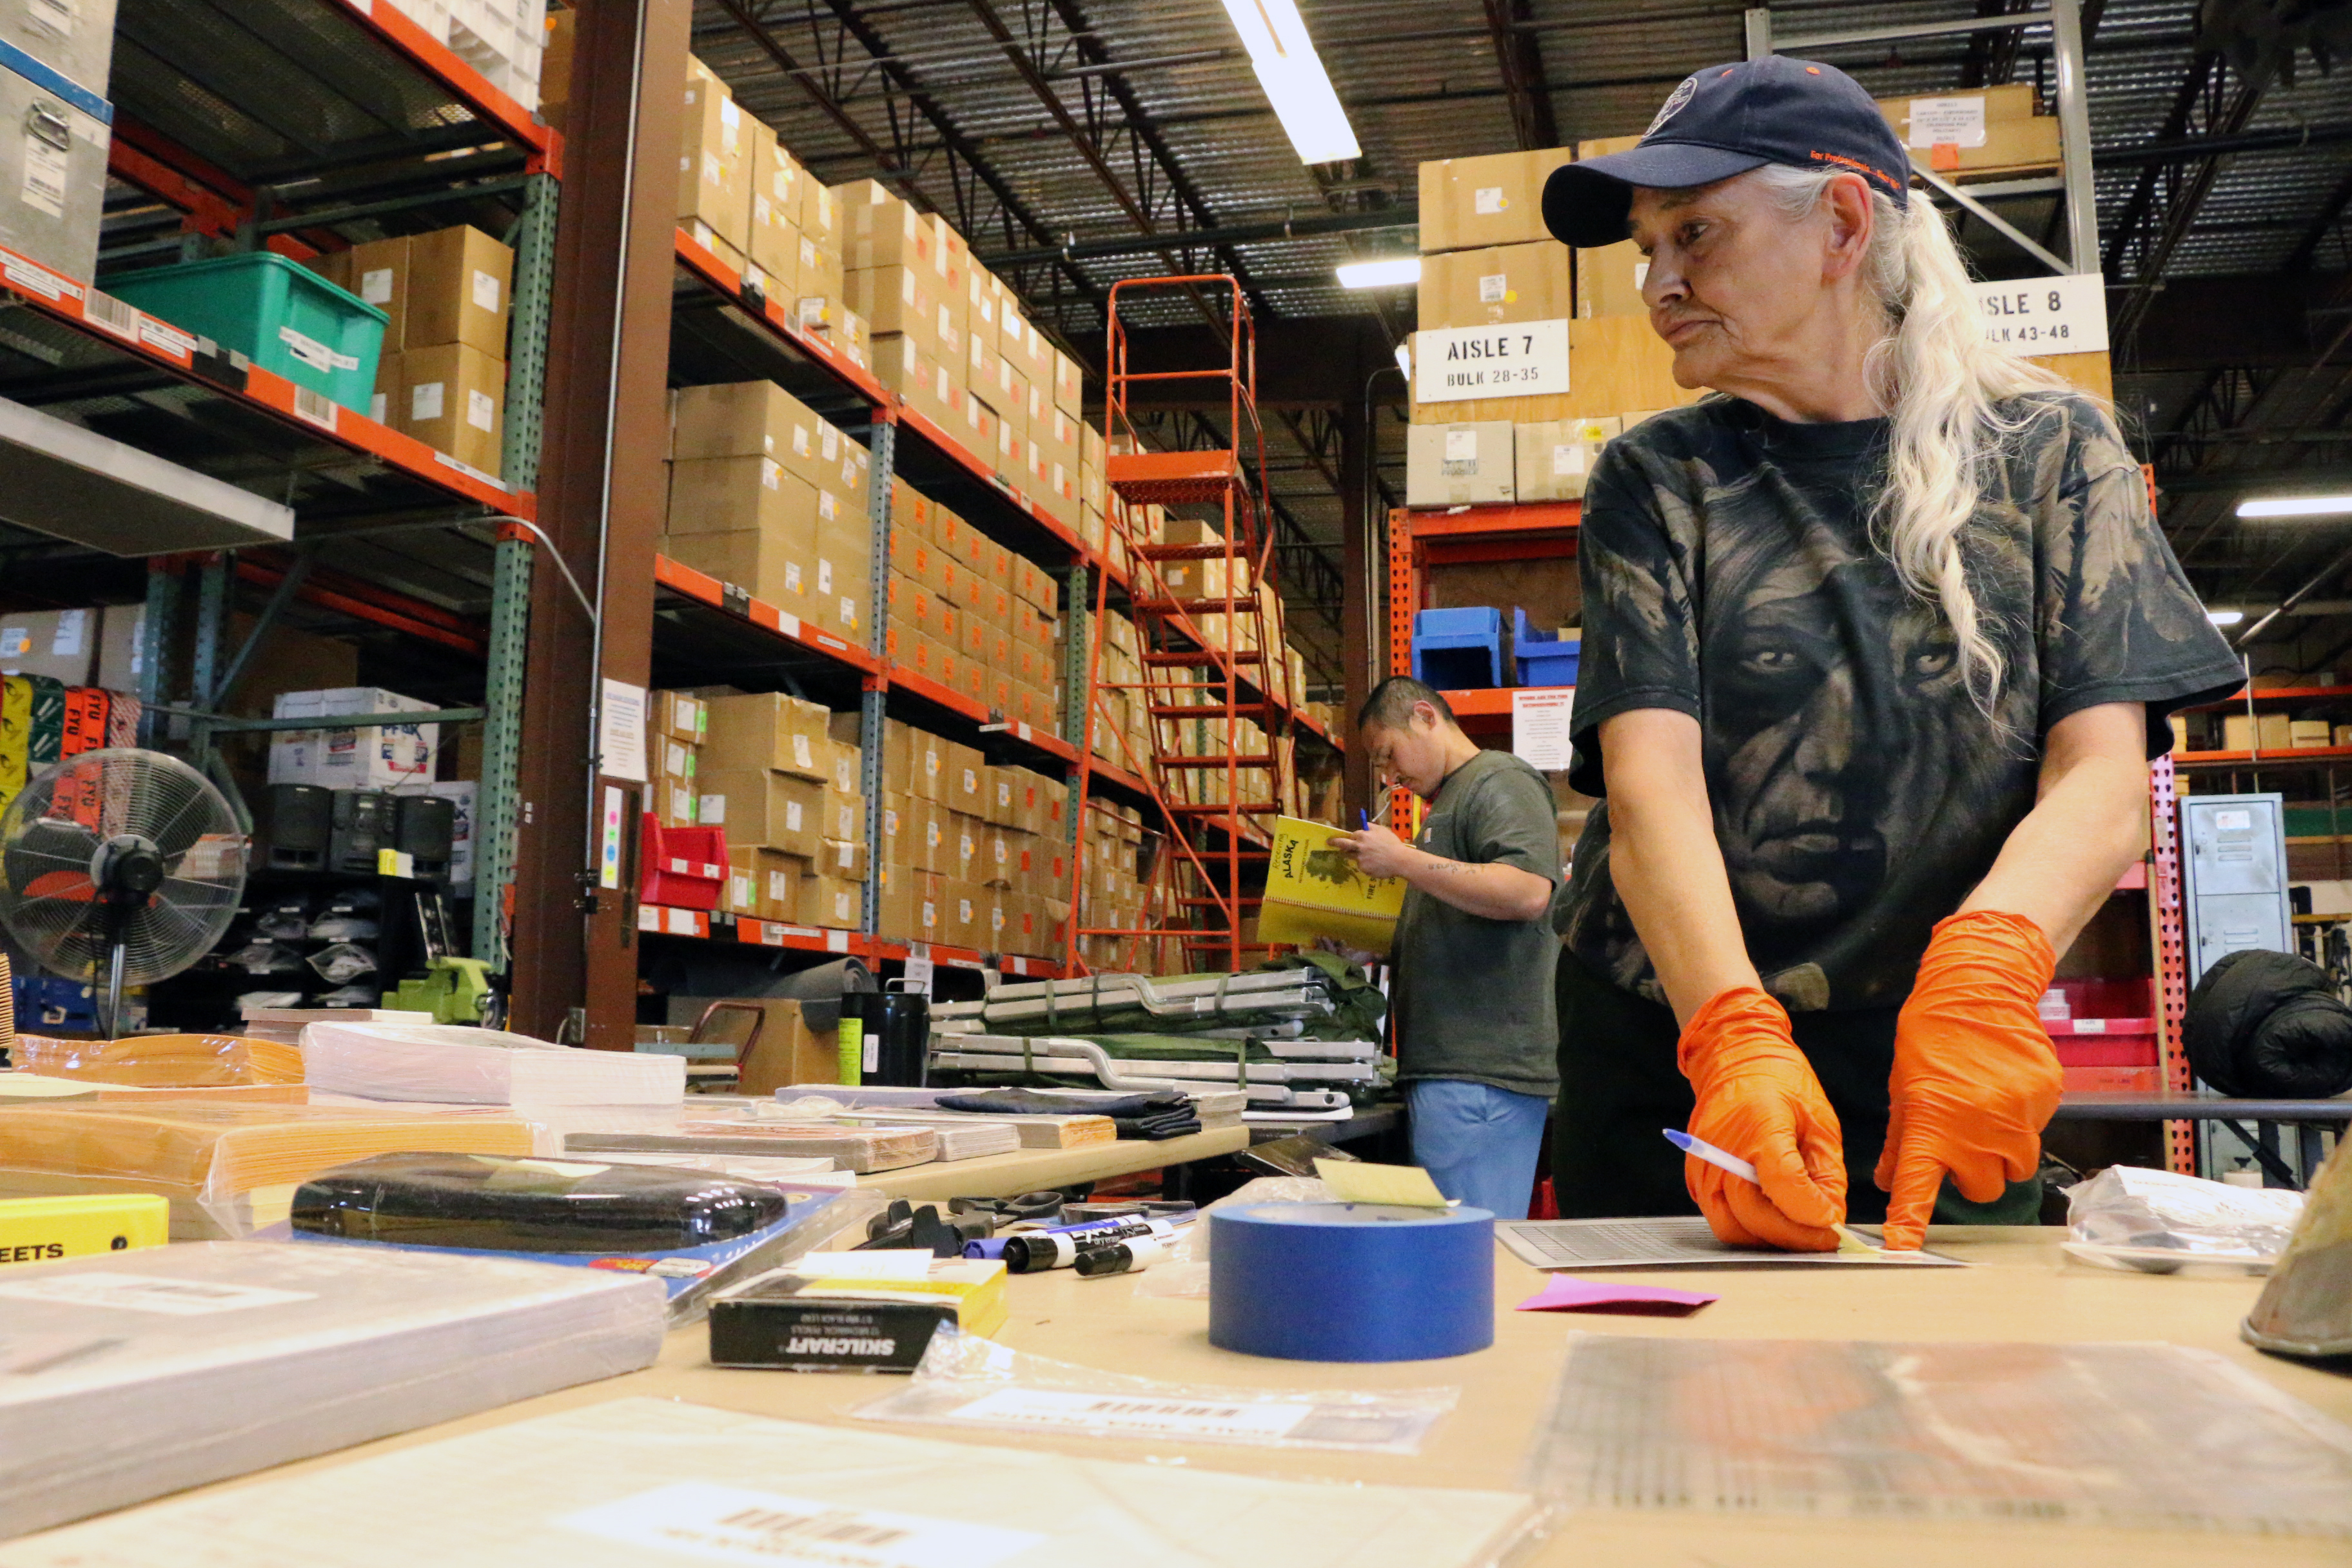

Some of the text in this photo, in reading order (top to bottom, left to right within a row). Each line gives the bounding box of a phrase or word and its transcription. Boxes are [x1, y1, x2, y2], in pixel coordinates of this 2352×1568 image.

[1810, 150, 1824, 161] For
[2048, 291, 2061, 311] 8
[2018, 324, 2069, 340] 43-48
[1447, 335, 1533, 361] AISLE 7
[1447, 367, 1538, 387] BULK 28-35
[88, 694, 101, 721] FYU
[66, 709, 81, 736] FYU
[1272, 833, 1289, 870] Receiving
[1282, 839, 1299, 878] ALASKA
[1367, 884, 1376, 899] FIRE
[0, 1244, 63, 1262] EETS
[1093, 1239, 1105, 1247] dry
[785, 1337, 896, 1356] SKILCRAFT
